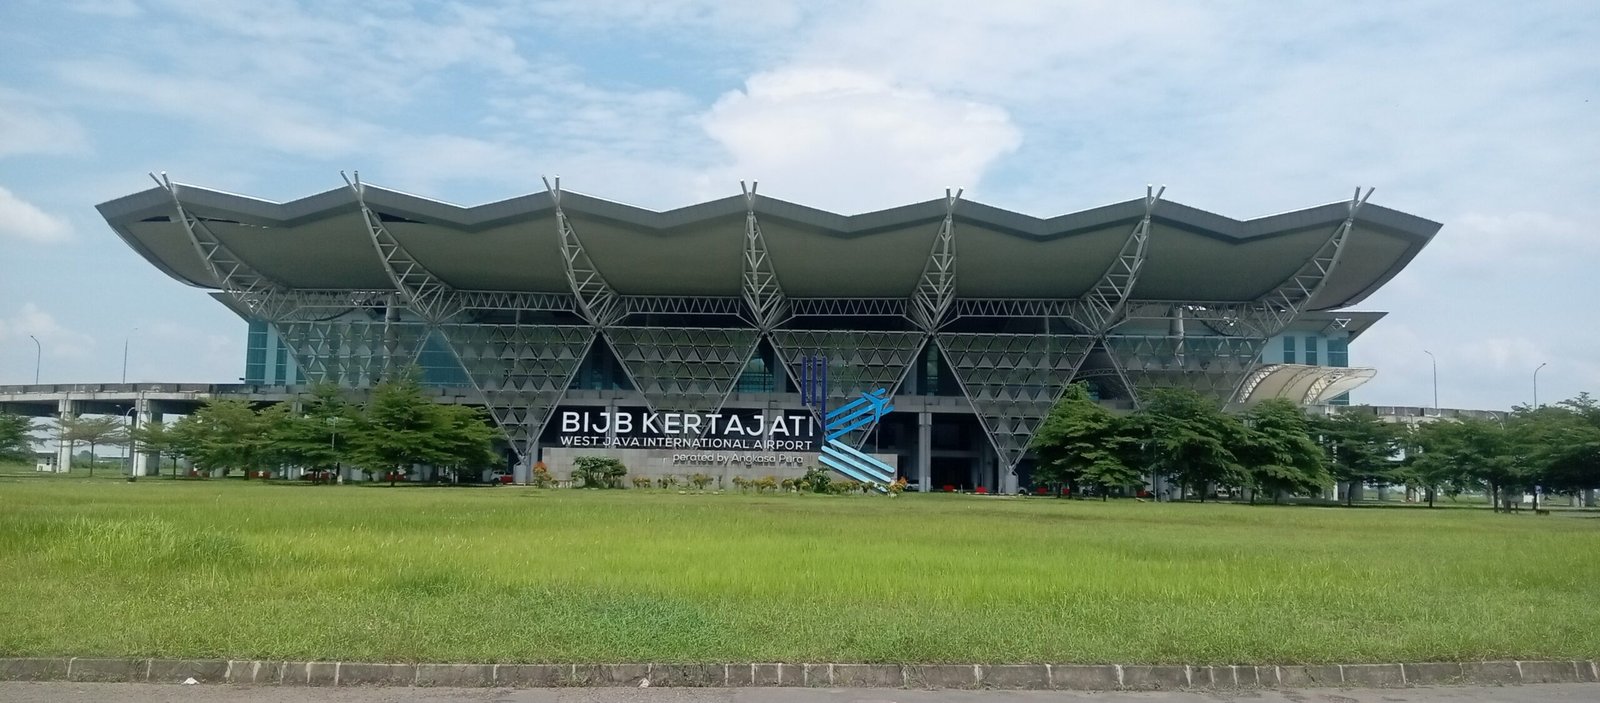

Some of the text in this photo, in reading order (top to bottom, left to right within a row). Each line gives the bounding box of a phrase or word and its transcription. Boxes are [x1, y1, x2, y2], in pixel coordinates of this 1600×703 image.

[562, 411, 814, 437] BIJB KERTAJATI
[560, 436, 812, 450] WEST JAVA INTERNATIONAL AIRPORT
[717, 453, 729, 464] by
[731, 453, 776, 465] Angkasa
[779, 454, 804, 463] Pura
